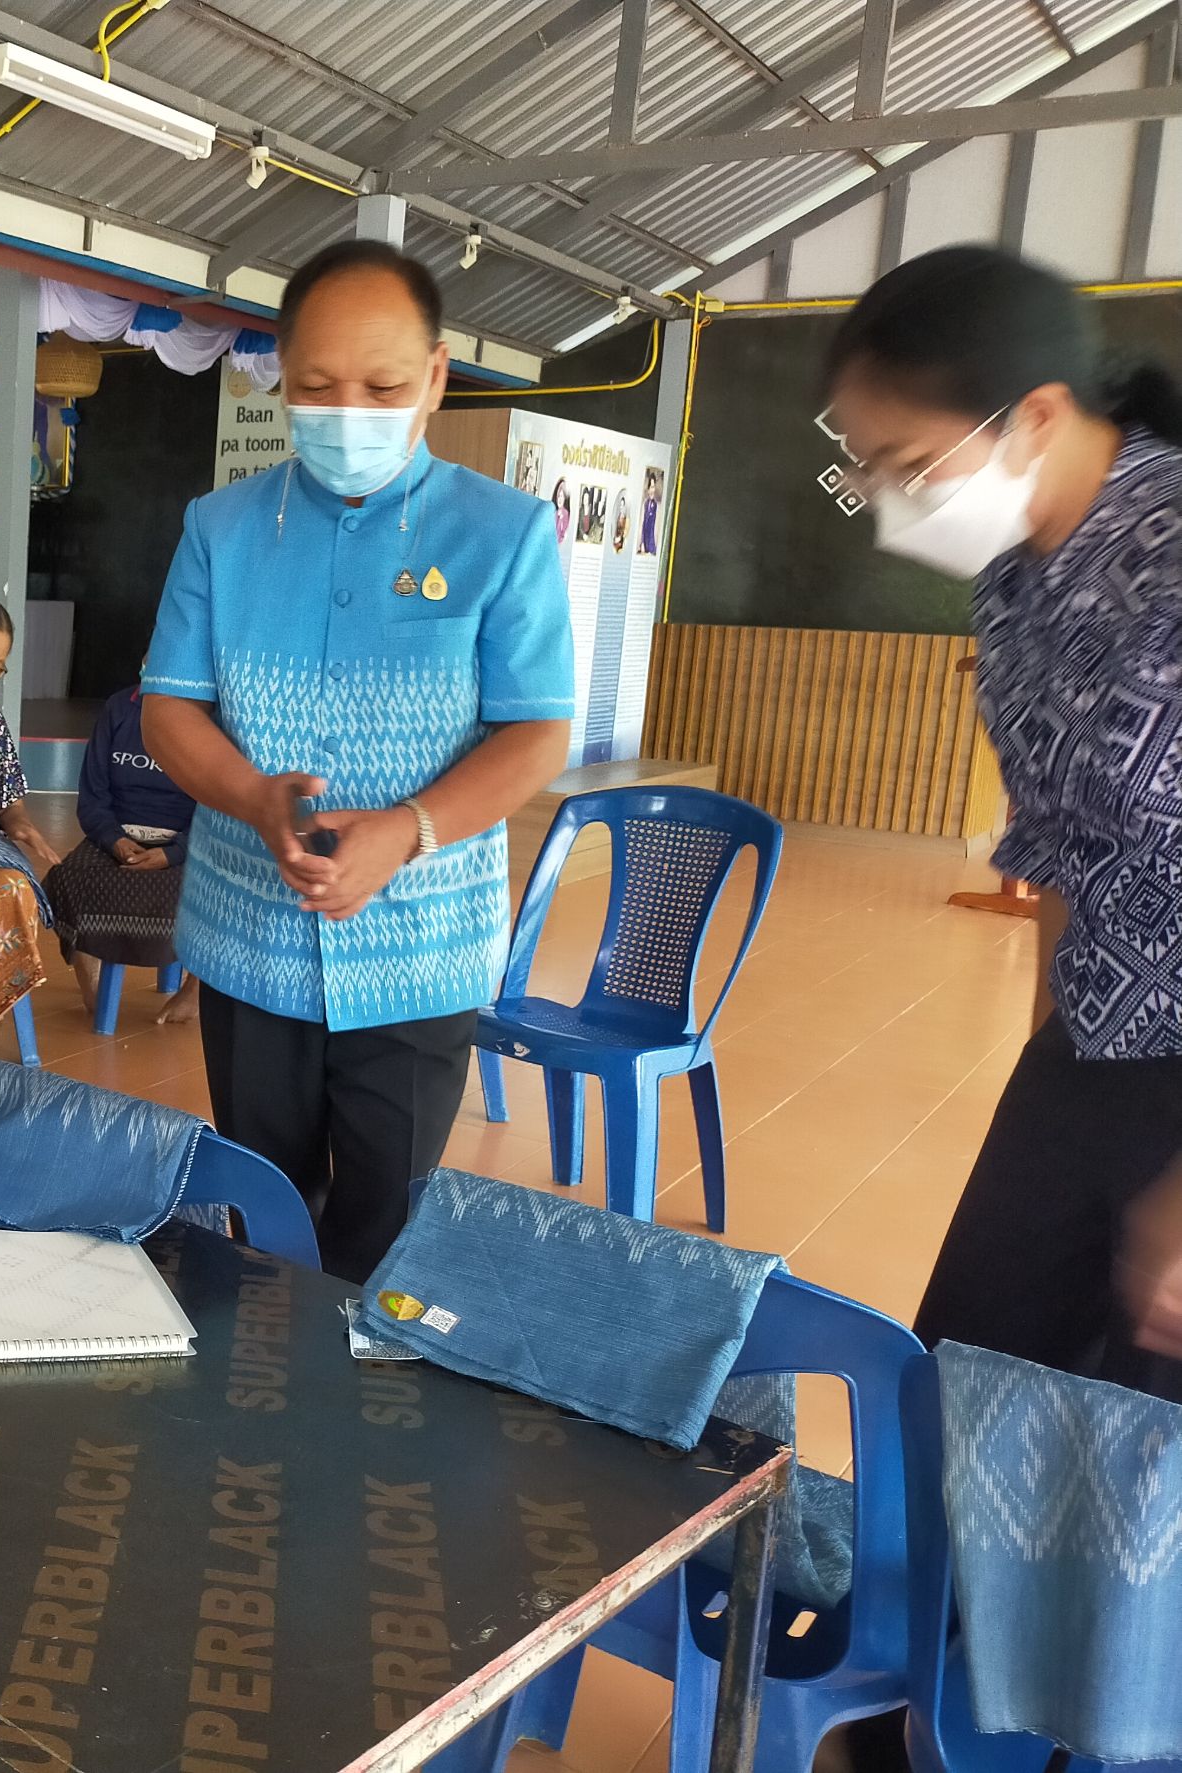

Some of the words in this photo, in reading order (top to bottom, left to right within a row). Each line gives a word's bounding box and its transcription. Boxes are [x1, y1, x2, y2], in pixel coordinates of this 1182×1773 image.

[236, 406, 273, 423] Baan
[221, 439, 239, 457] pa
[245, 436, 285, 452] toom
[229, 467, 247, 484] pa
